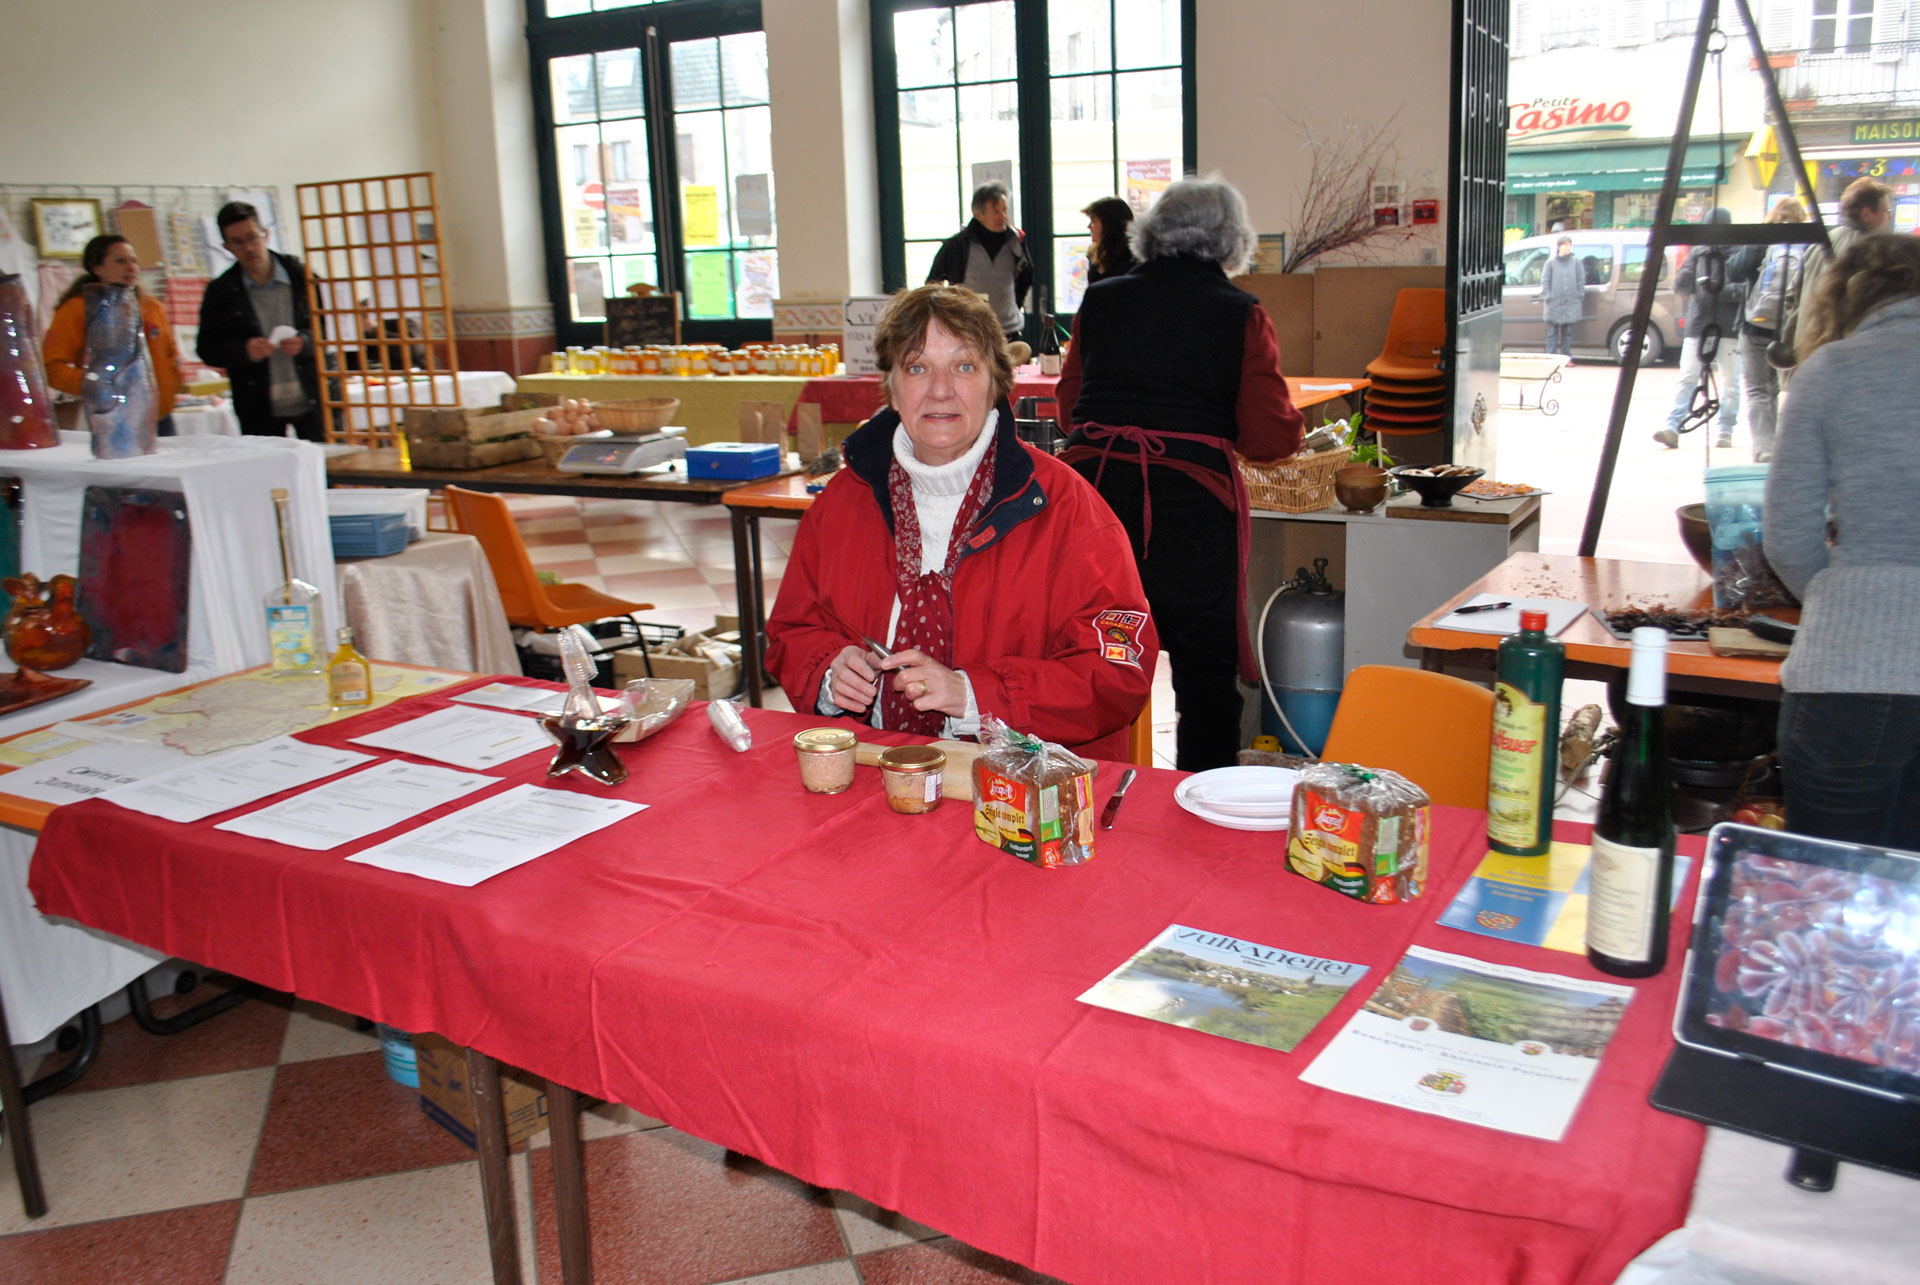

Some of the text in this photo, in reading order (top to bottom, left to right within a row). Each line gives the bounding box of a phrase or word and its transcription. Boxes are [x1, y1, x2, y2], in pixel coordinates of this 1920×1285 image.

[1532, 97, 1570, 108] Petit
[1507, 98, 1631, 137] Casino
[1100, 619, 1135, 631] CANADIAN
